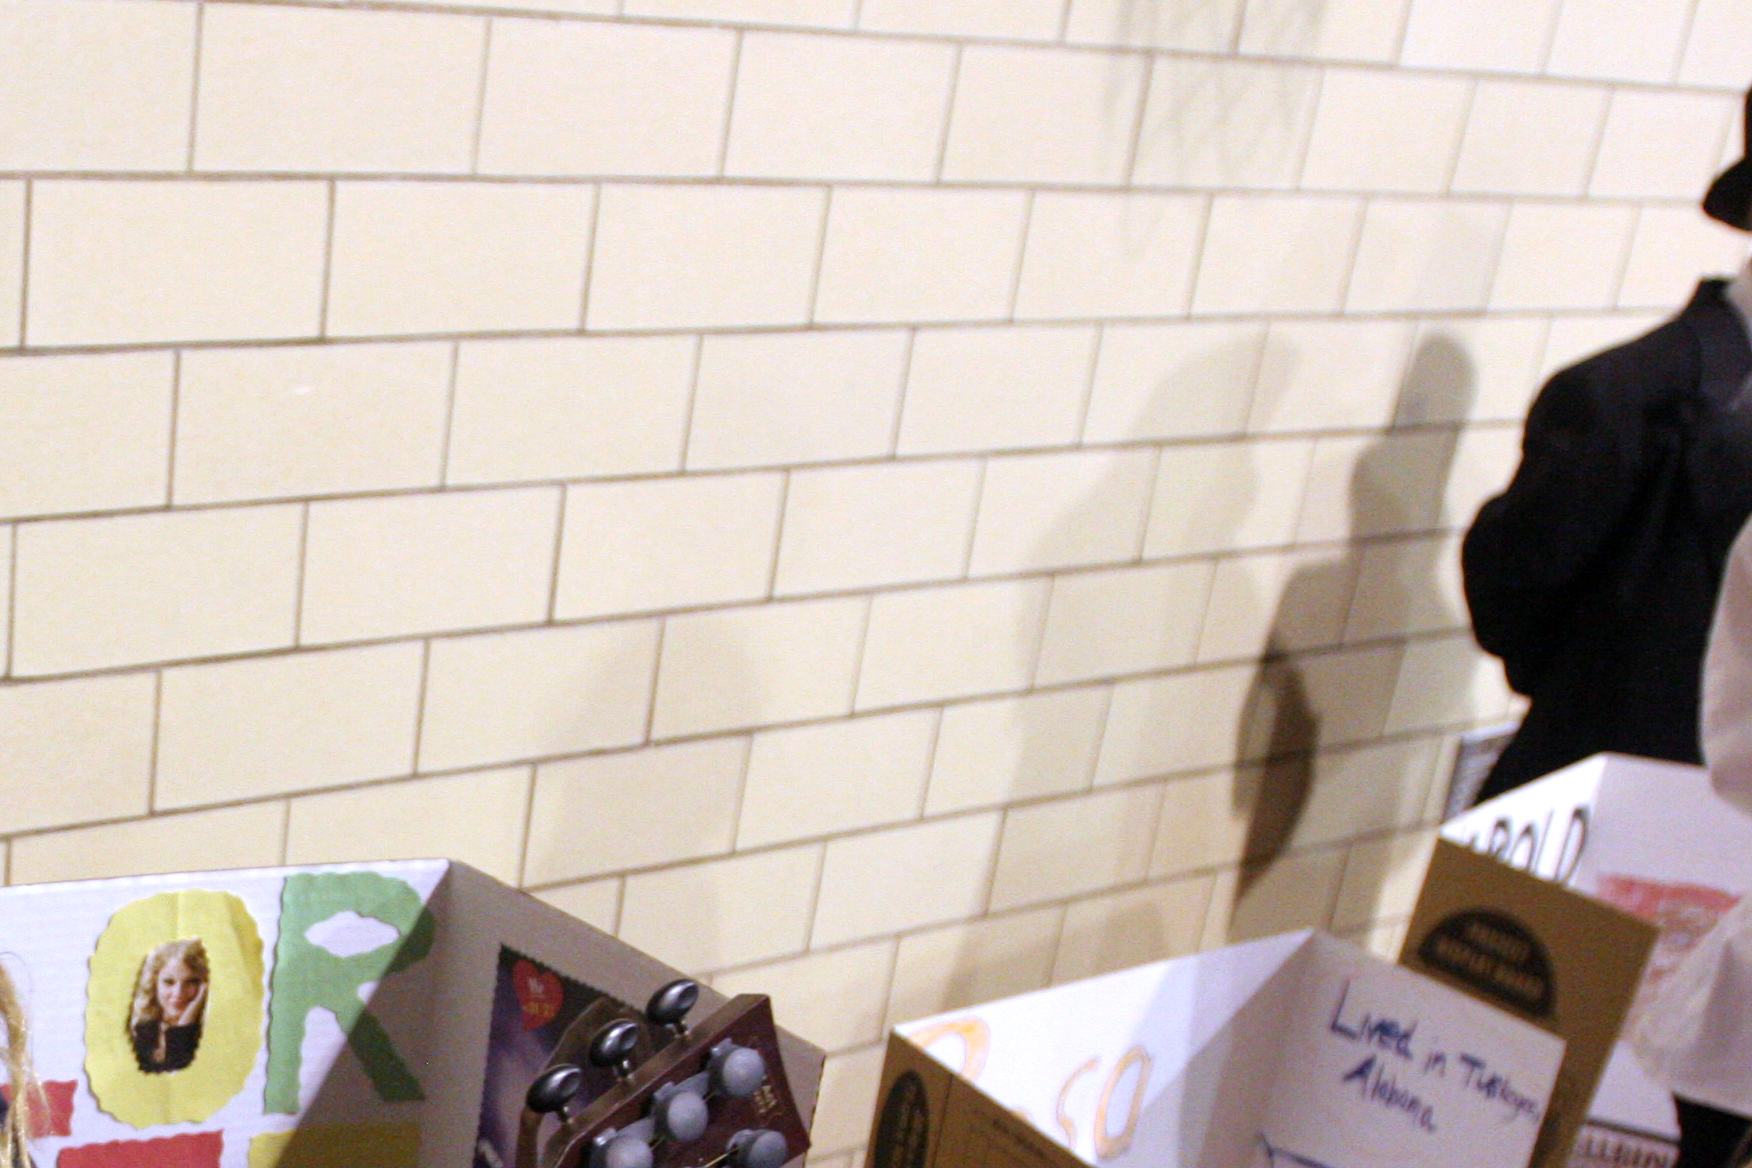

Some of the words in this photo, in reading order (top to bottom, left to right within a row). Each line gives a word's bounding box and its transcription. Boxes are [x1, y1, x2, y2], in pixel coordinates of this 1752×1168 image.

[1331, 979, 1418, 1061] Lived
[1424, 1037, 1447, 1079] in
[1343, 1054, 1437, 1135] Alabama
